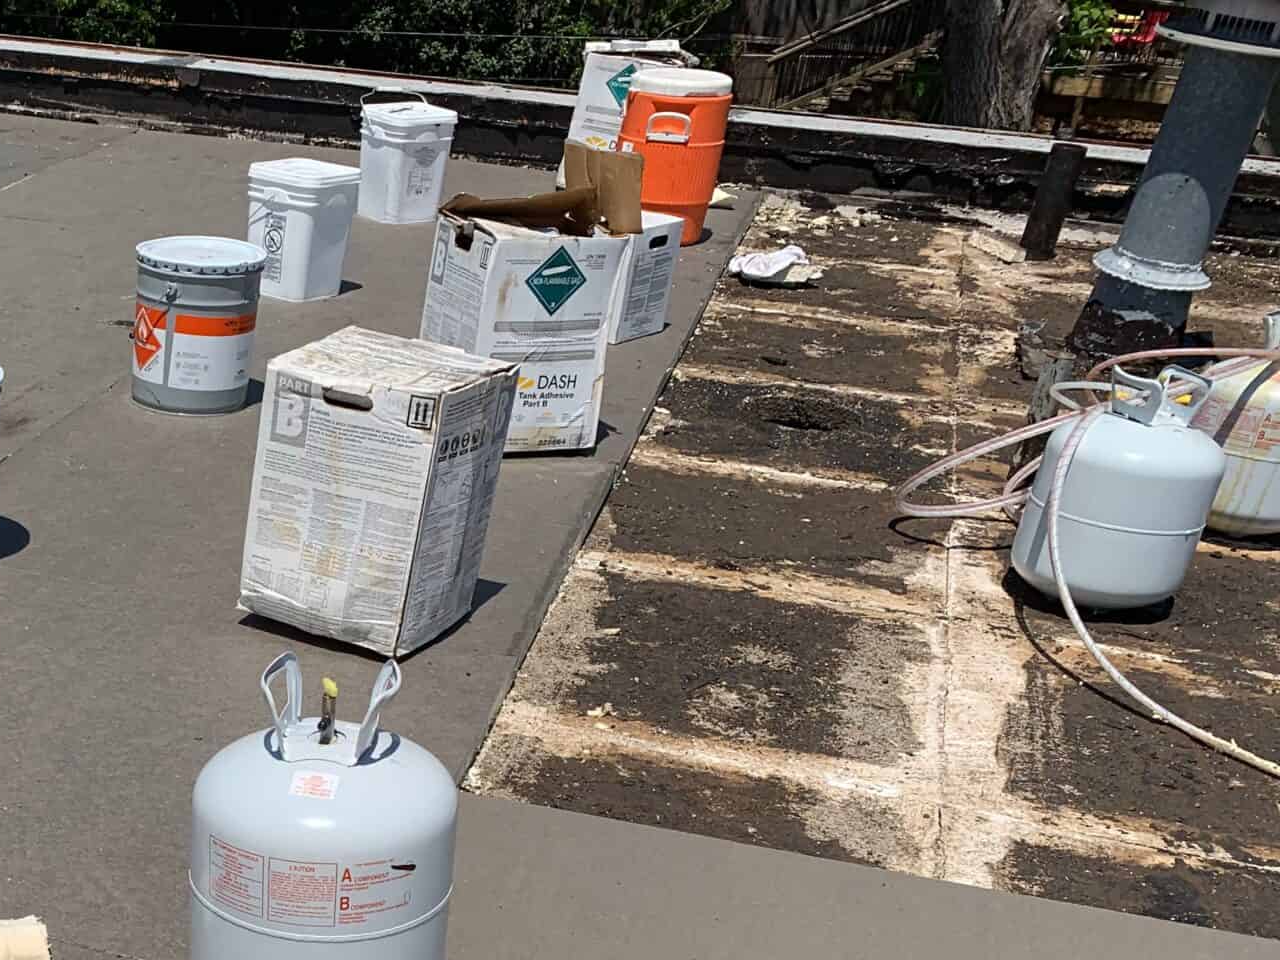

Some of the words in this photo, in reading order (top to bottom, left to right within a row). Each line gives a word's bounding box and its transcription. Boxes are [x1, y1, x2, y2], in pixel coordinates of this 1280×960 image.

[278, 375, 310, 394] PART
[537, 374, 577, 389] DASH
[276, 396, 305, 437] B
[342, 867, 352, 882] A
[340, 896, 350, 911] B
